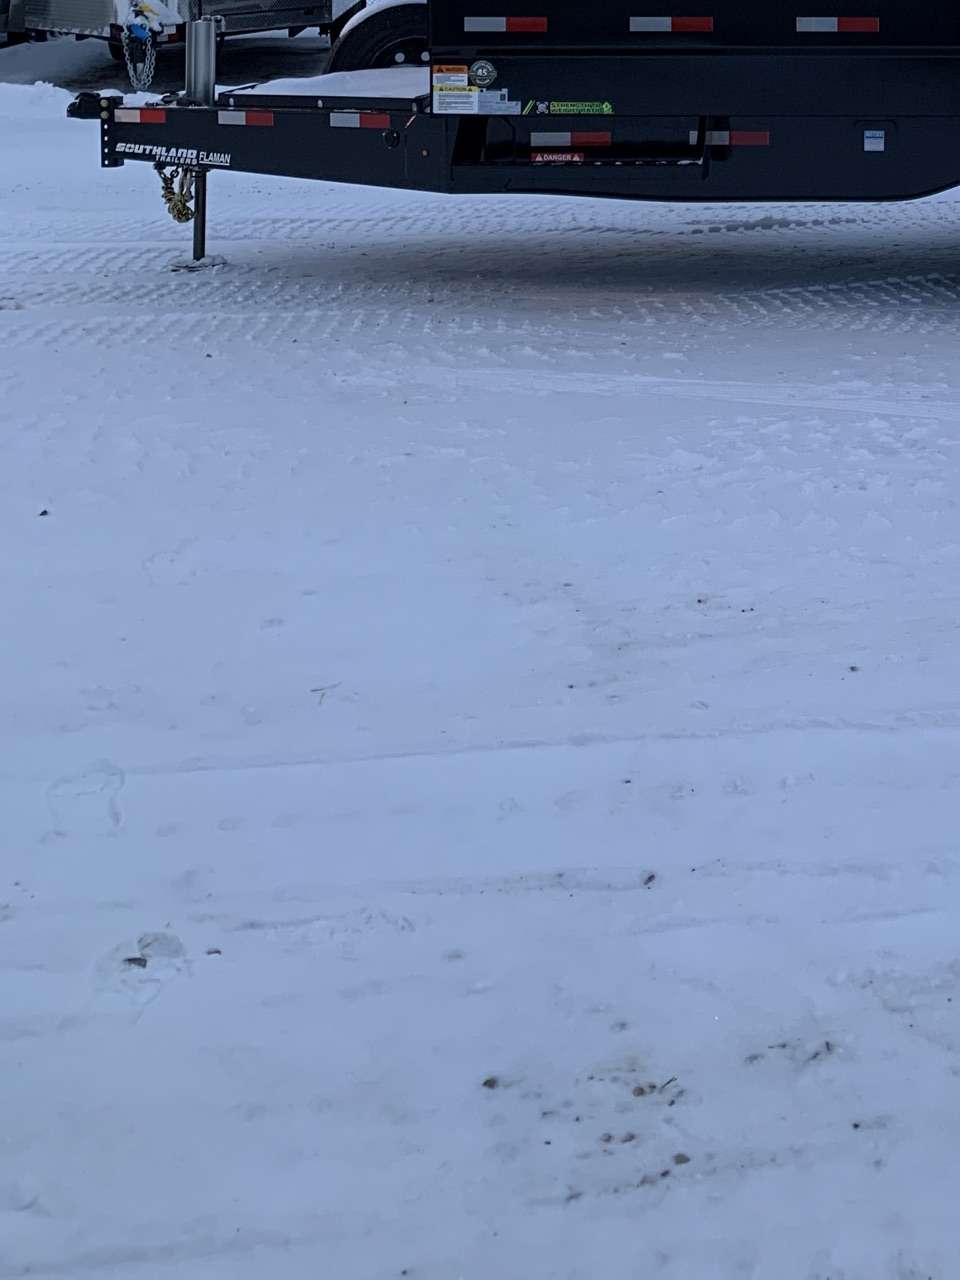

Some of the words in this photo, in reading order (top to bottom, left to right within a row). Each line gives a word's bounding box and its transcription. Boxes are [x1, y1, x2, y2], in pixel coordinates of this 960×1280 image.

[115, 142, 198, 158] SOUTHLAND
[155, 156, 198, 165] TRAILERS
[199, 151, 231, 164] FLAMAN
